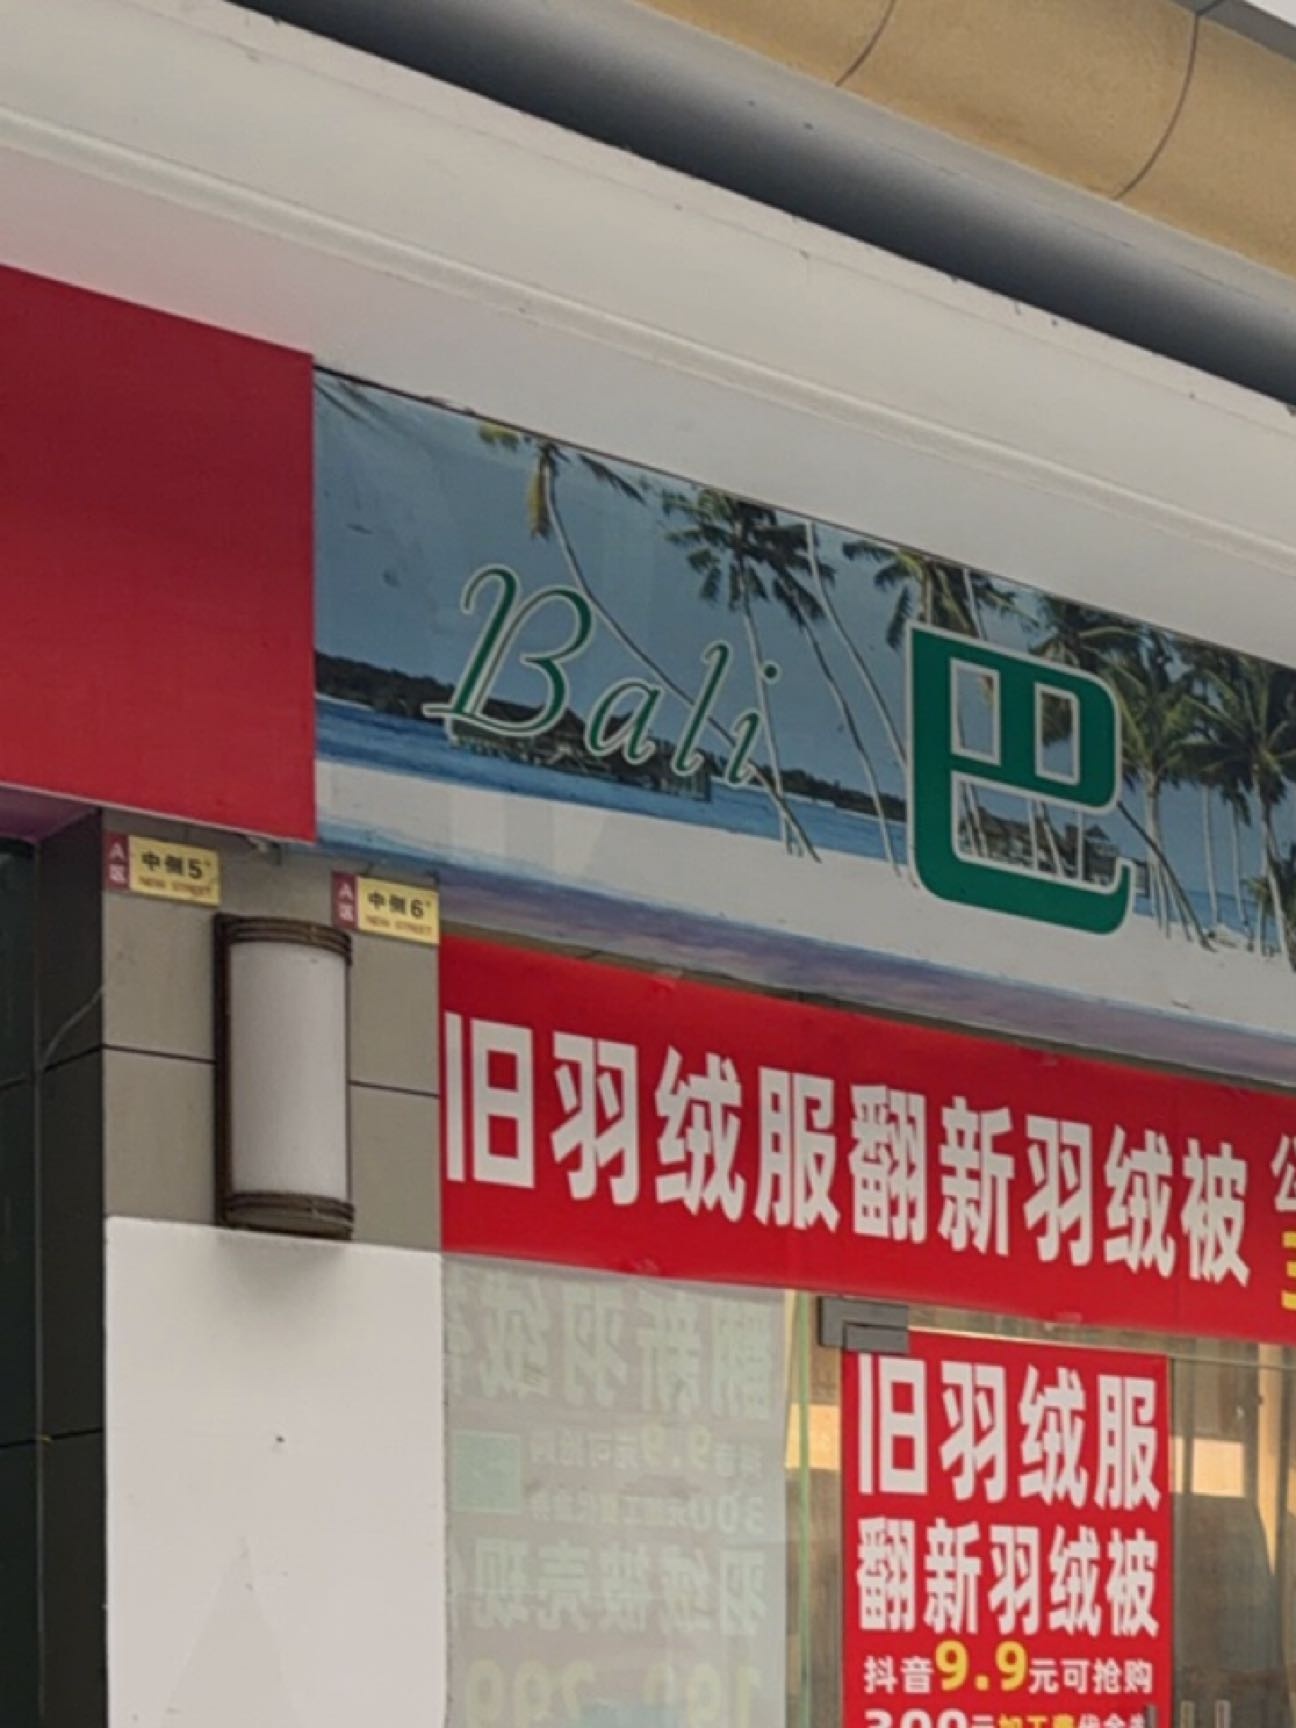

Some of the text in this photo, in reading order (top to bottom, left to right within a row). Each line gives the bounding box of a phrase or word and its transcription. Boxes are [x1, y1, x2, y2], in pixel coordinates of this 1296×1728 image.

[423, 564, 781, 786] Bali
[444, 1012, 1249, 1286] 旧羽绒服翻新羽绒被
[857, 1353, 1161, 1511] 旧羽绒服
[856, 1516, 1159, 1637] 翻新羽绒被
